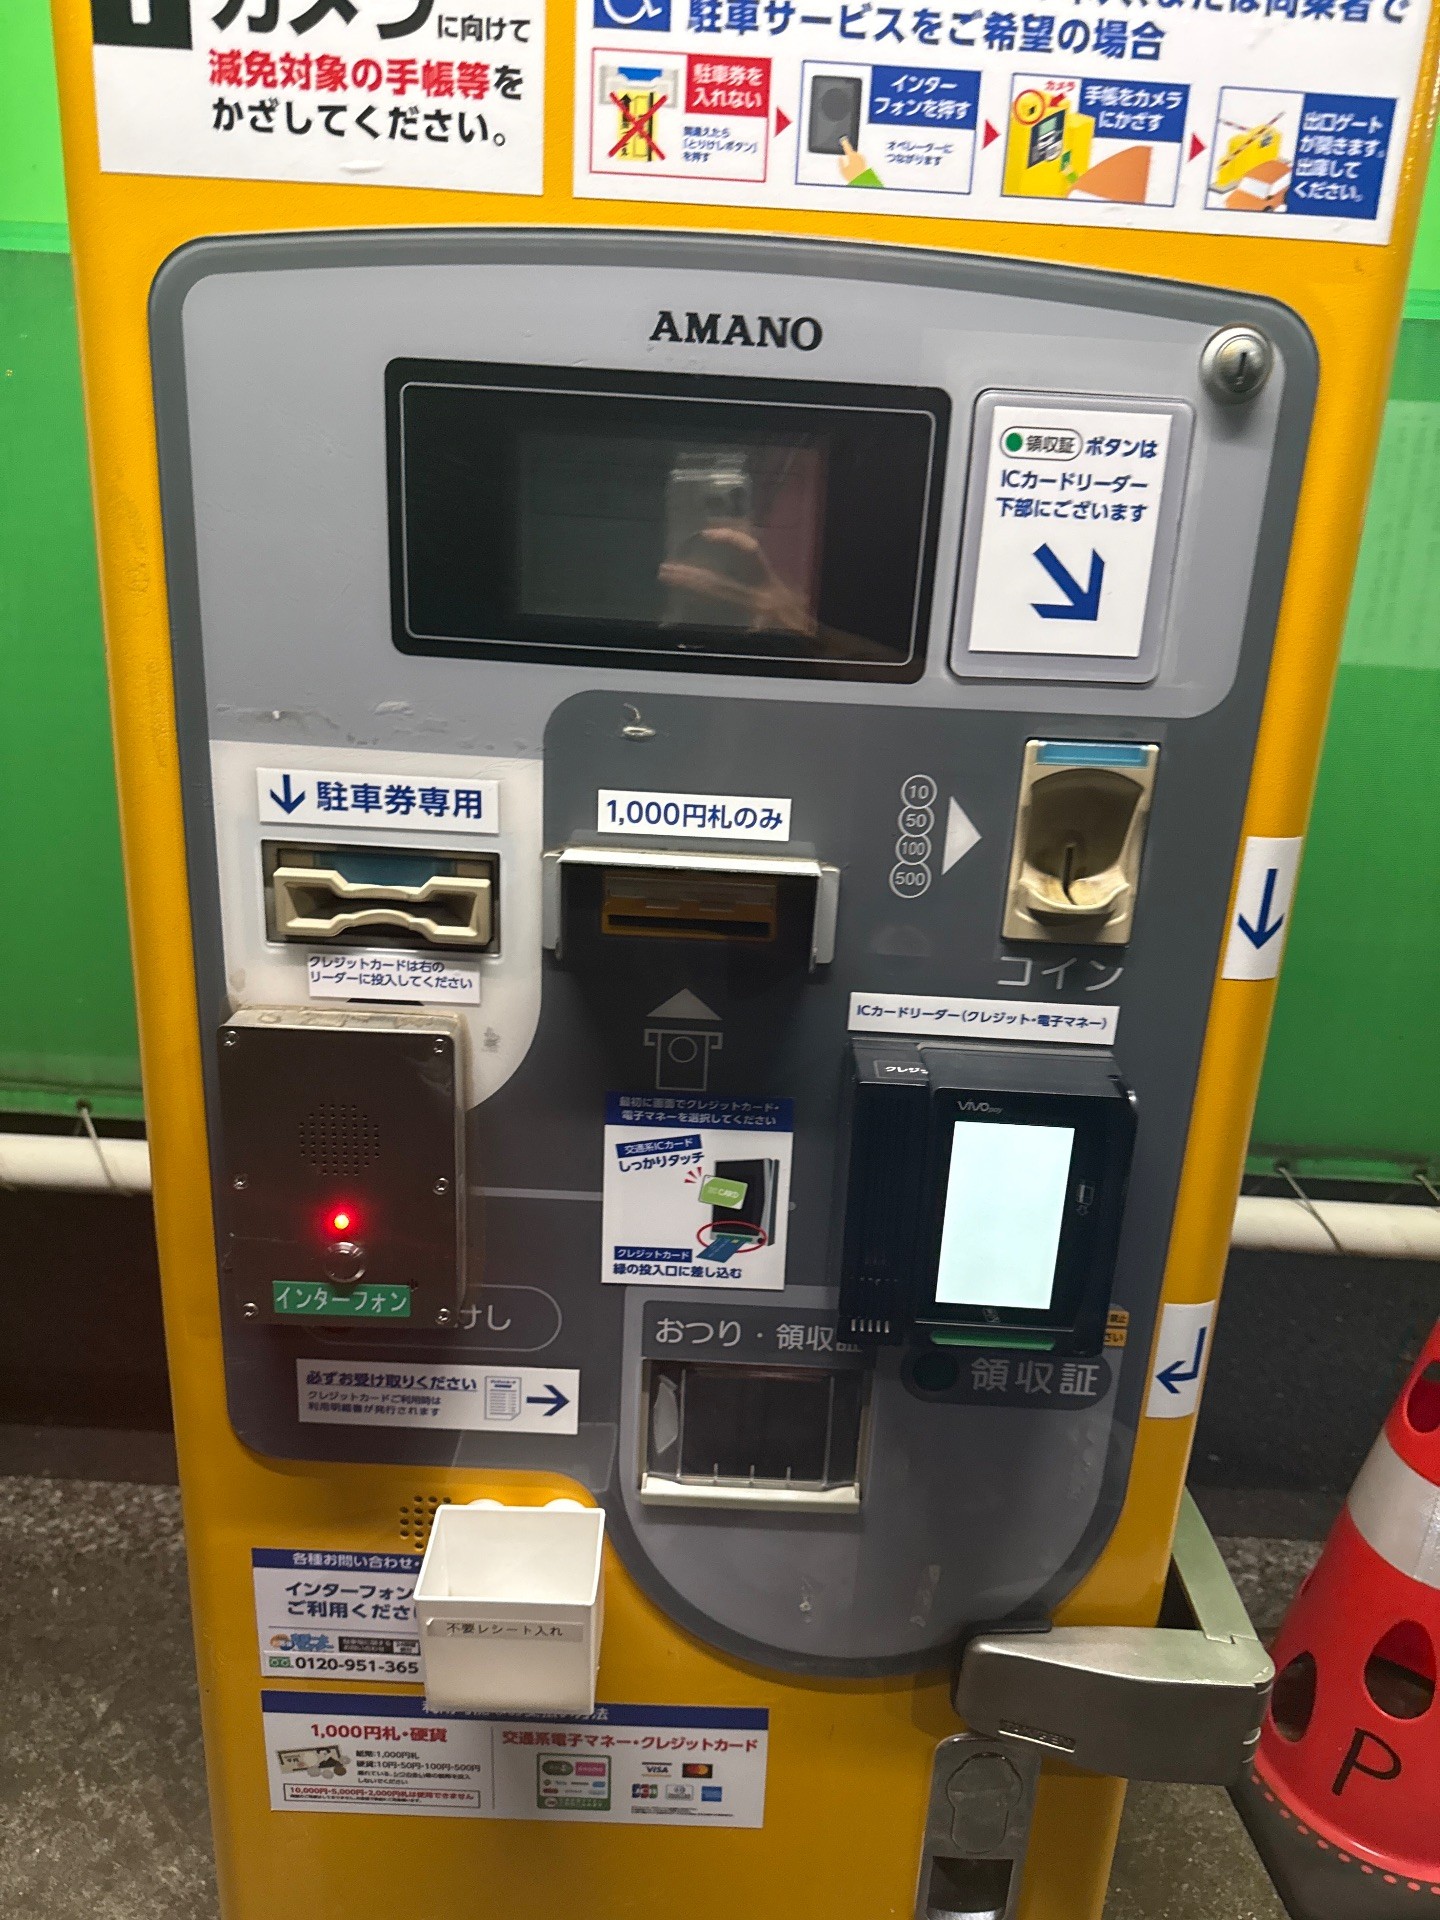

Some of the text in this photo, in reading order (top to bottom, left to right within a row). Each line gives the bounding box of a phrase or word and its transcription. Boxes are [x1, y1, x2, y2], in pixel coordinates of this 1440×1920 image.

[208, 48, 525, 100] 減免対象の手帳等を
[692, 62, 764, 87] 駐車券を
[890, 74, 958, 95] インター
[692, 87, 763, 109] 入れない
[874, 96, 972, 120] フォンを押す
[211, 97, 508, 147] かざしてください。
[1098, 111, 1164, 132] にかざす
[1303, 111, 1383, 134] 出口ゲート
[1293, 181, 1364, 203] ください。
[649, 310, 824, 352] AMANO
[1026, 434, 1157, 460] 領収証 ボタンは
[1000, 468, 1148, 492] ICカードリーダー
[995, 496, 1148, 523] 下部にございます
[316, 780, 483, 820] 駐車券専用
[908, 785, 930, 800] 10
[606, 798, 784, 831] 1,000円札のみ
[905, 813, 928, 829] 50
[902, 841, 926, 856] 100
[895, 871, 926, 887] 500
[309, 956, 446, 974] クレジットカードは右の
[996, 955, 1125, 992] コイン
[311, 972, 474, 991] リーダーに投入してください
[621, 1109, 777, 1126] 電子マネーを選択してください
[624, 1138, 694, 1156] 交通系ICカード
[618, 1151, 705, 1173] しっかりタッチ
[617, 1248, 690, 1260] クレジットカード
[612, 1262, 743, 1280] 緑の投入口に差し込む
[275, 1287, 408, 1312] インターフォン
[305, 1369, 478, 1391] 必ずお受け取りください
[971, 1356, 1102, 1397] 領収証
[447, 1621, 564, 1638] 不要レシート入れ
[295, 1656, 419, 1675] 0120-951-365
[310, 1723, 448, 1743] 1,000円札・硬貨
[502, 1731, 758, 1752] 交通系電子マネー・クレジットカード
[1331, 1727, 1402, 1796] P
